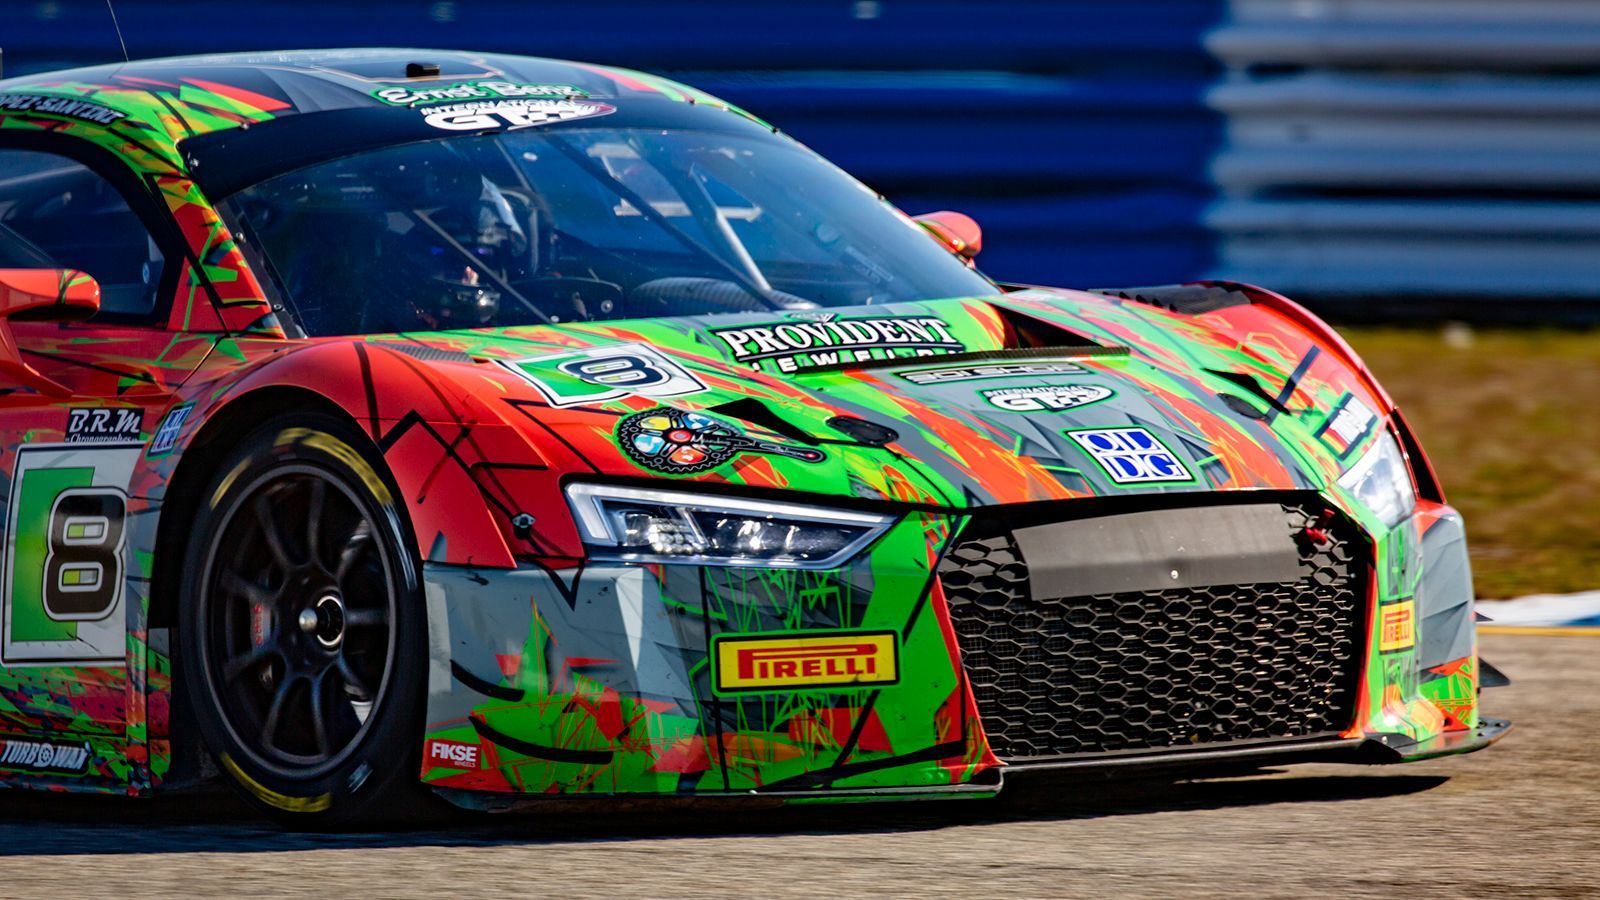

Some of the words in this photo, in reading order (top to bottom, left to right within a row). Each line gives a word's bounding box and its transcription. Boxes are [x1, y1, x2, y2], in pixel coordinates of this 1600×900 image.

[378, 84, 488, 103] Ernst
[477, 81, 585, 97] Benz
[420, 98, 576, 116] INTERNATIONAL
[716, 317, 958, 356] PROVIDENT
[557, 354, 672, 388] 8
[982, 385, 1084, 397] INTERNATIONAL
[42, 486, 127, 621] 8
[1382, 609, 1411, 643] PIRELLI
[737, 643, 878, 680] PIRELLI
[431, 742, 477, 763] FIKSE
